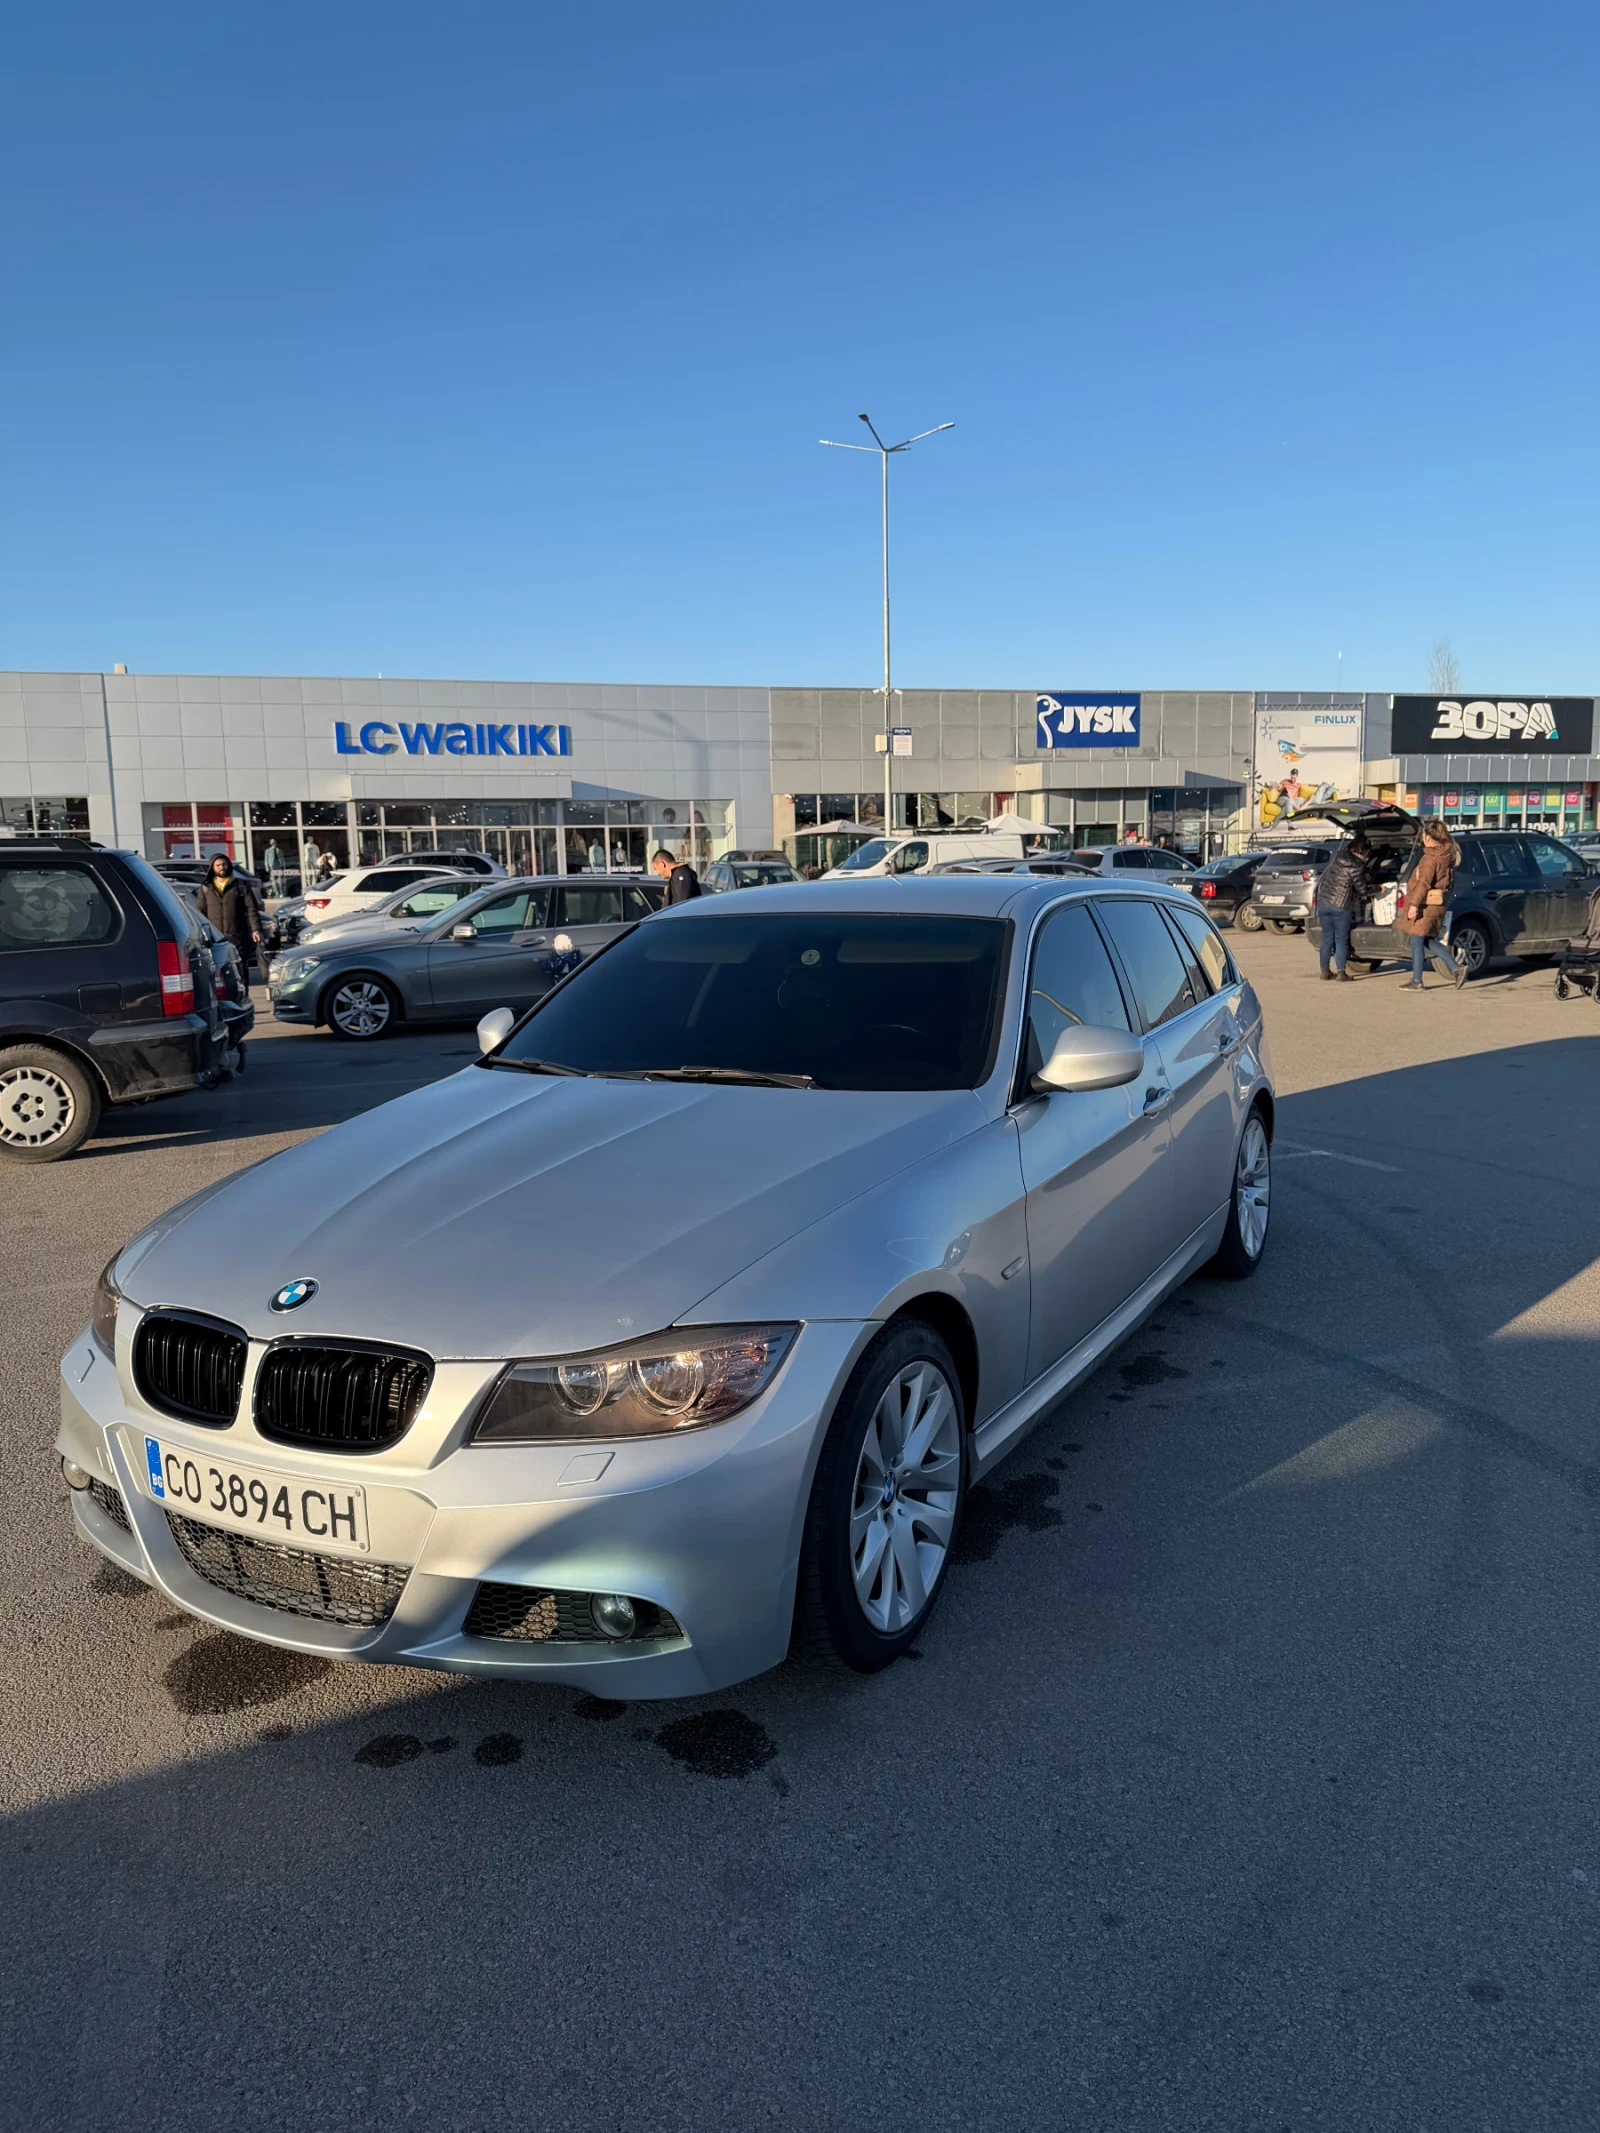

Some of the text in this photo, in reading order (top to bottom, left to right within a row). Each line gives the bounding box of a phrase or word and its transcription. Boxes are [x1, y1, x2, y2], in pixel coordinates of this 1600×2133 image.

[1057, 706, 1137, 733] JYSK
[1314, 715, 1357, 724] FINLUX
[1431, 701, 1559, 740] ЗОРА
[151, 1473, 163, 1488] BG
[164, 1453, 358, 1542] CO 3894 CH
